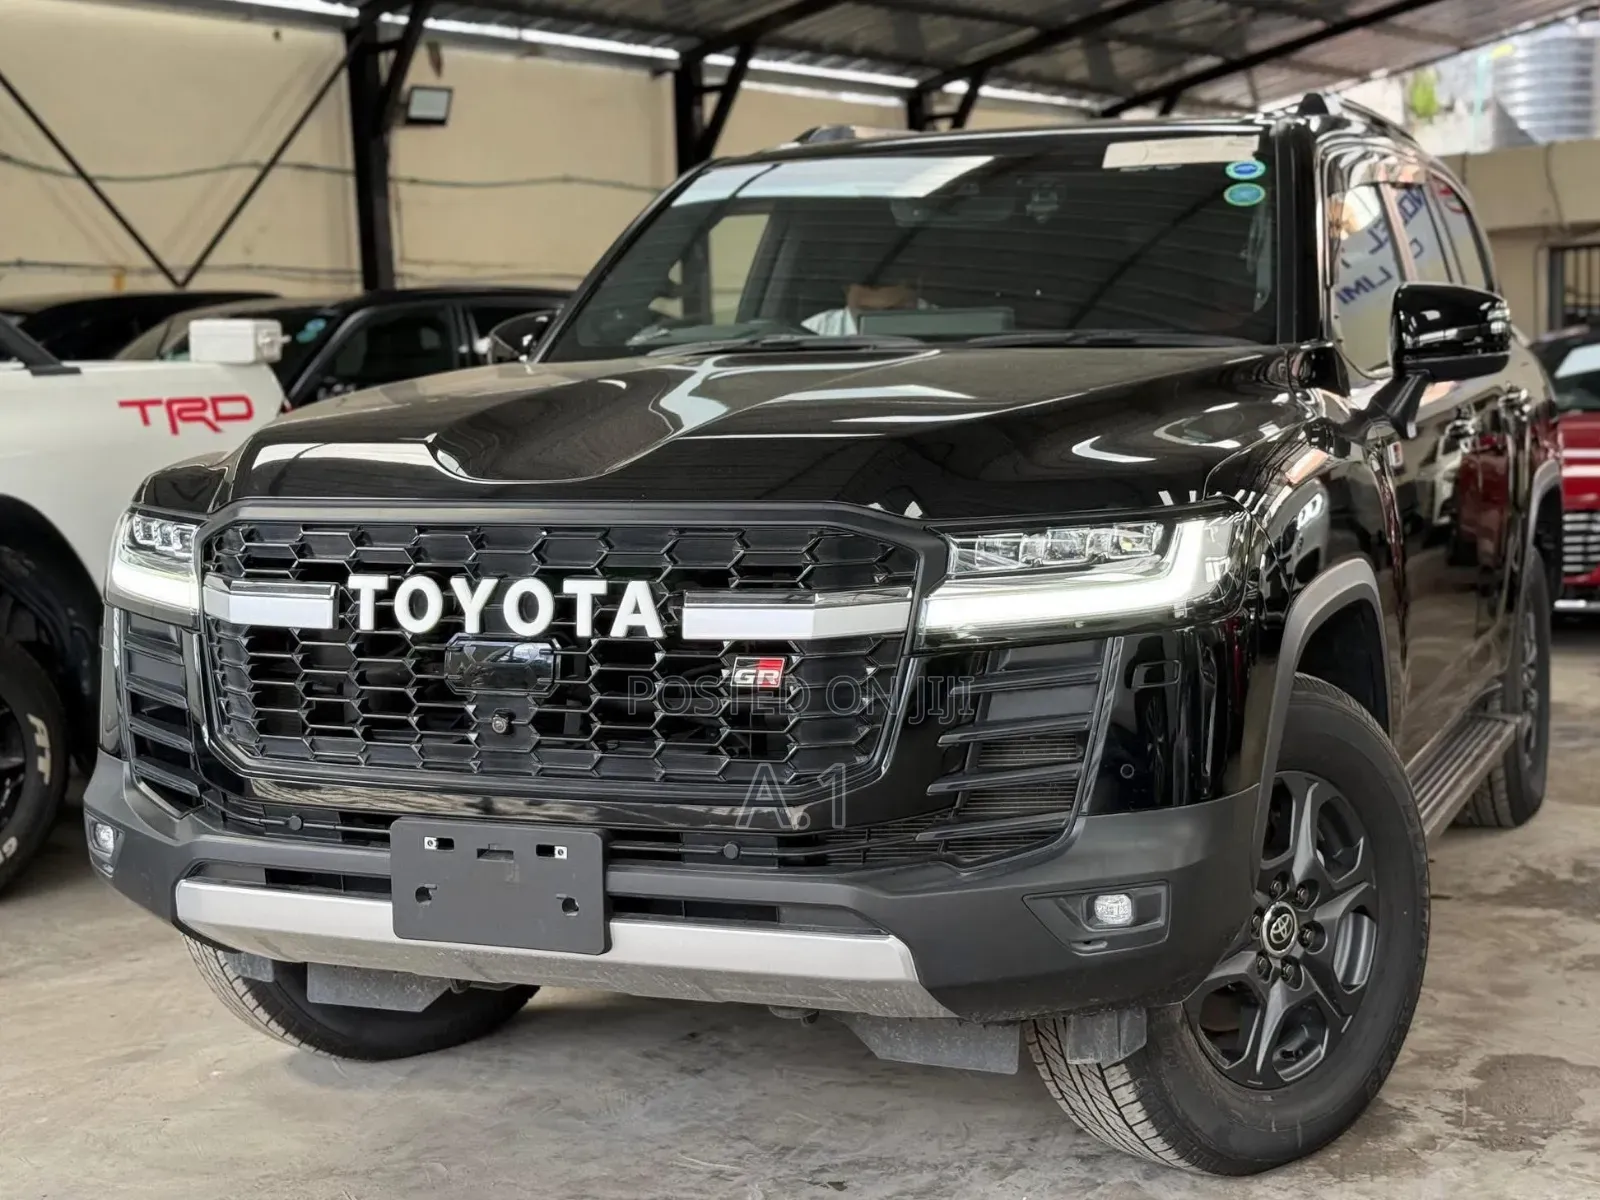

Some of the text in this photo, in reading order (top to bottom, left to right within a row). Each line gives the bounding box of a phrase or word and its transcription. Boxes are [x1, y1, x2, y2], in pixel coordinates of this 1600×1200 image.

[118, 394, 254, 435] TRD
[347, 574, 666, 637] TOYOTA
[733, 668, 782, 685] GR
